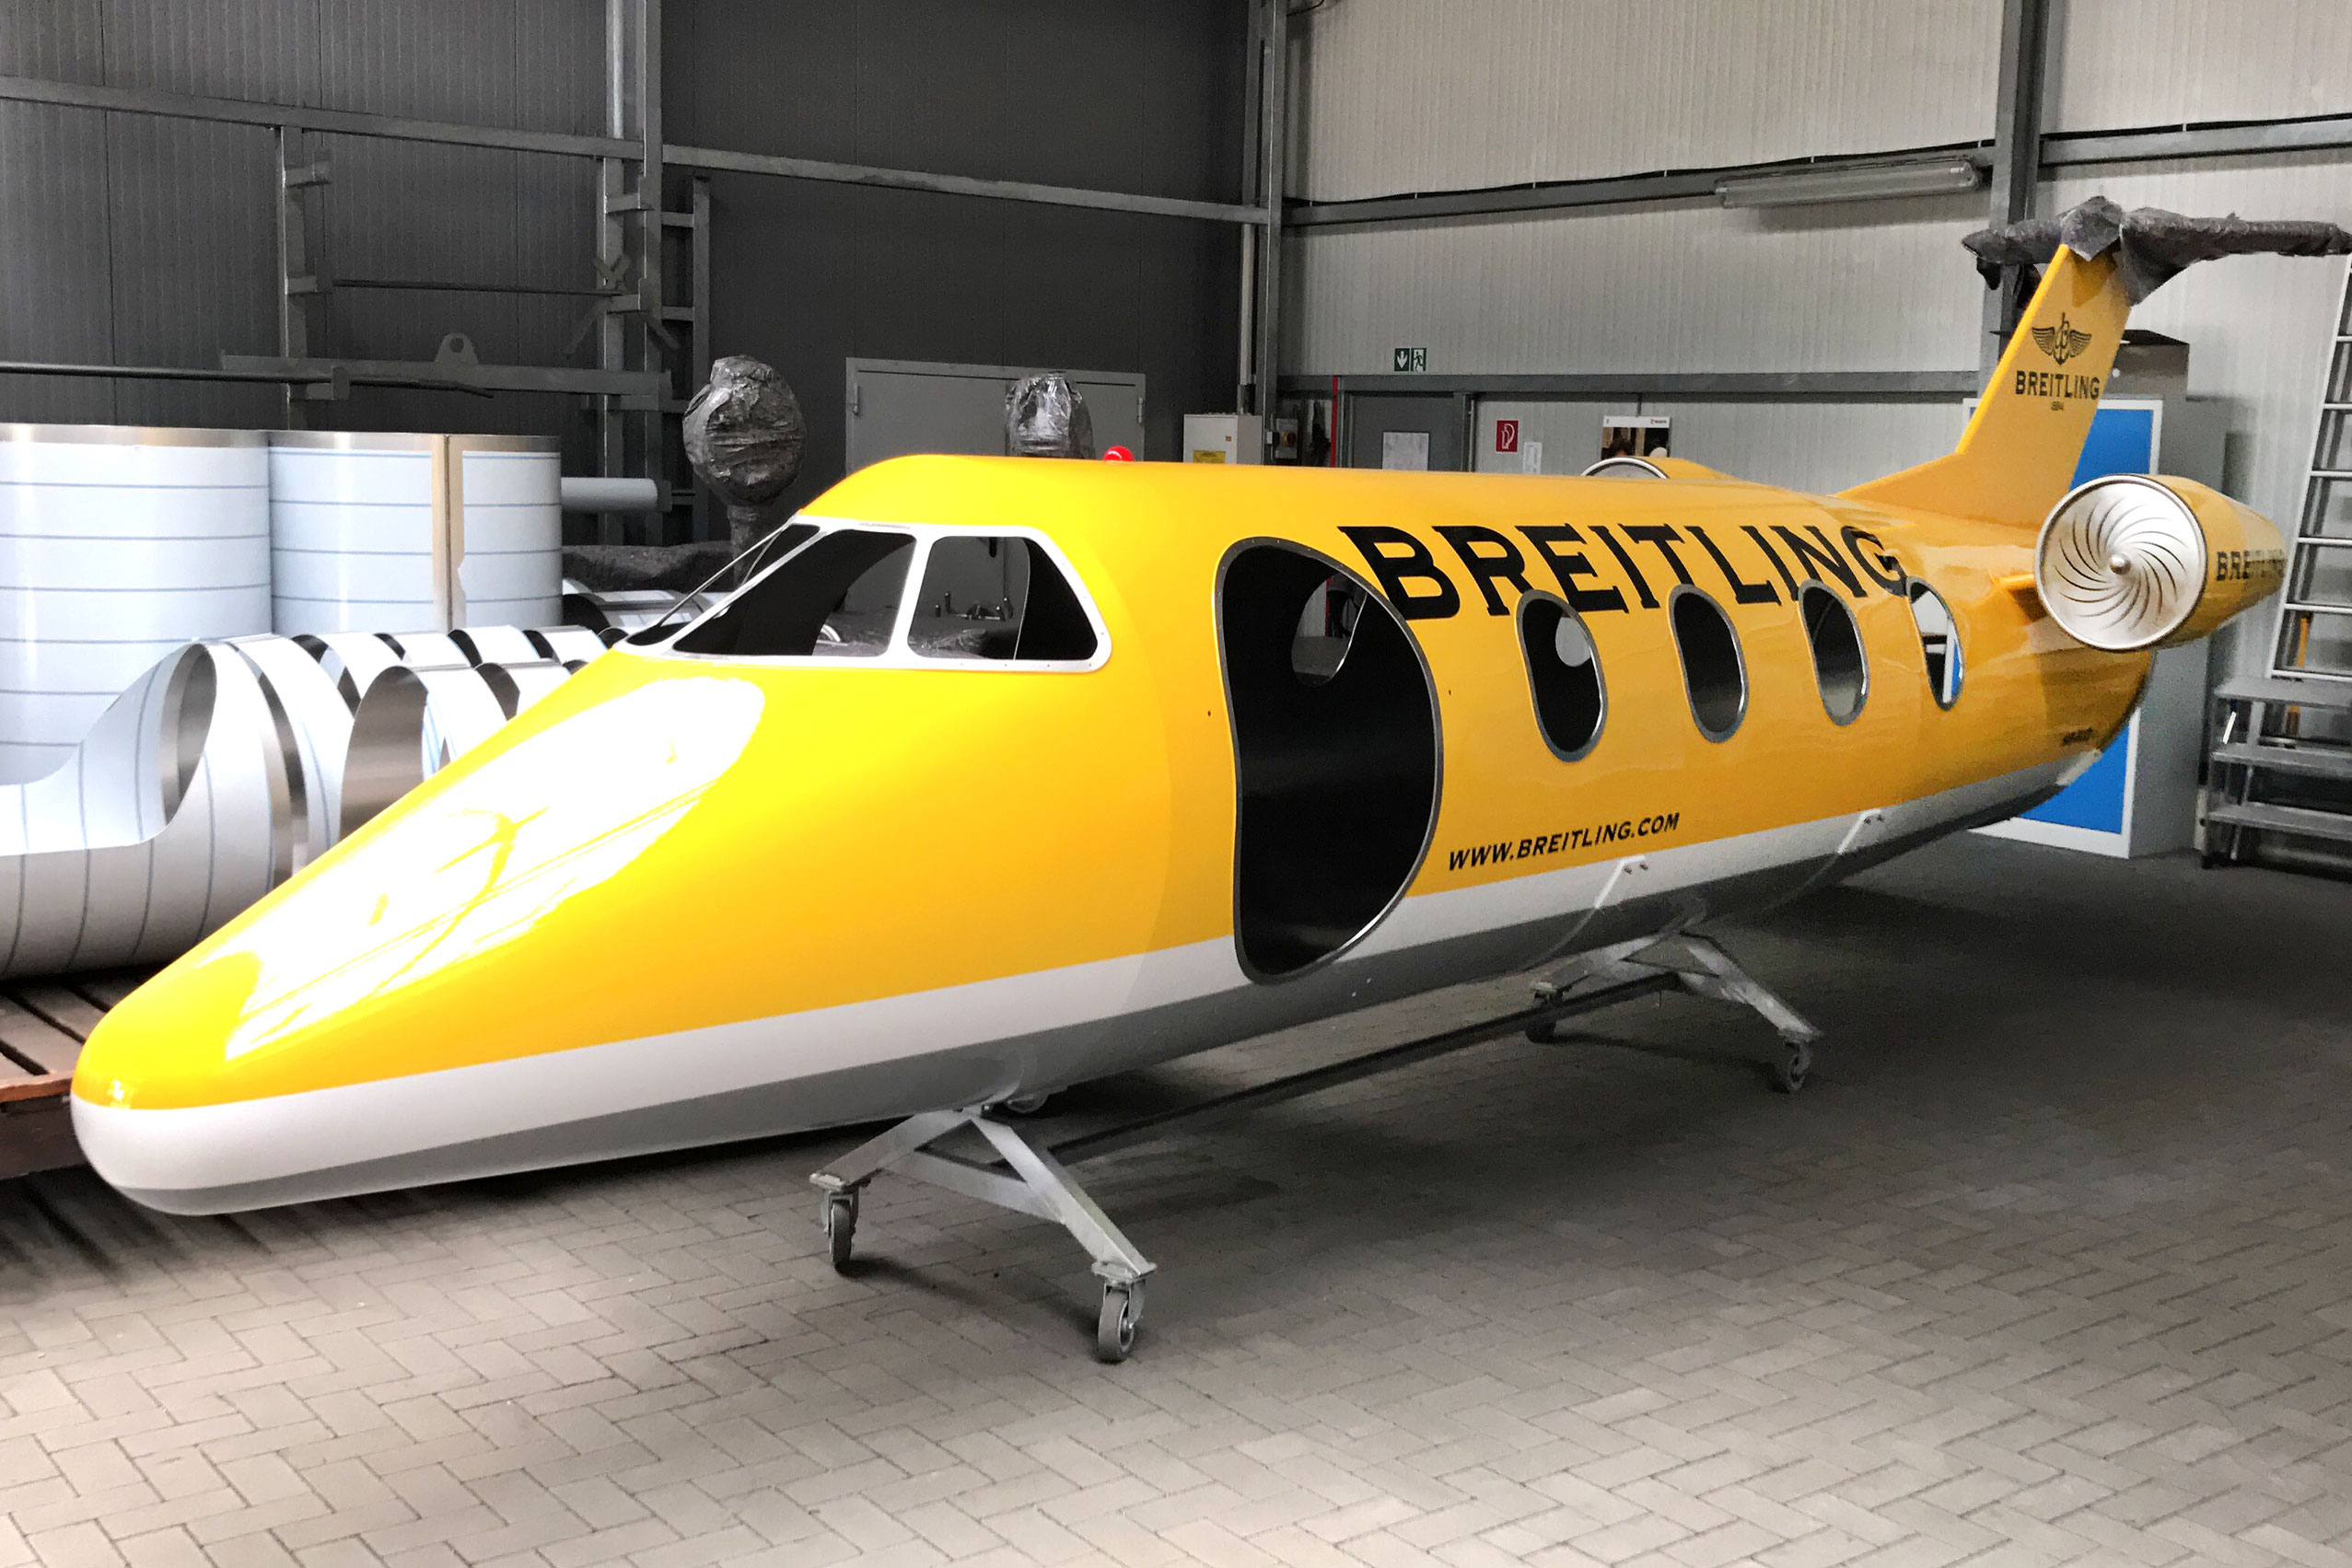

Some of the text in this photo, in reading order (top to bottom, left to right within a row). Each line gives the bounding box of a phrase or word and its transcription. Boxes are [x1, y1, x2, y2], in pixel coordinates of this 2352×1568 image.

[2015, 370, 2101, 401] BREITLING
[1336, 522, 1909, 621] BREITLING
[1448, 812, 1681, 871] WWW.BREITLING.COM
